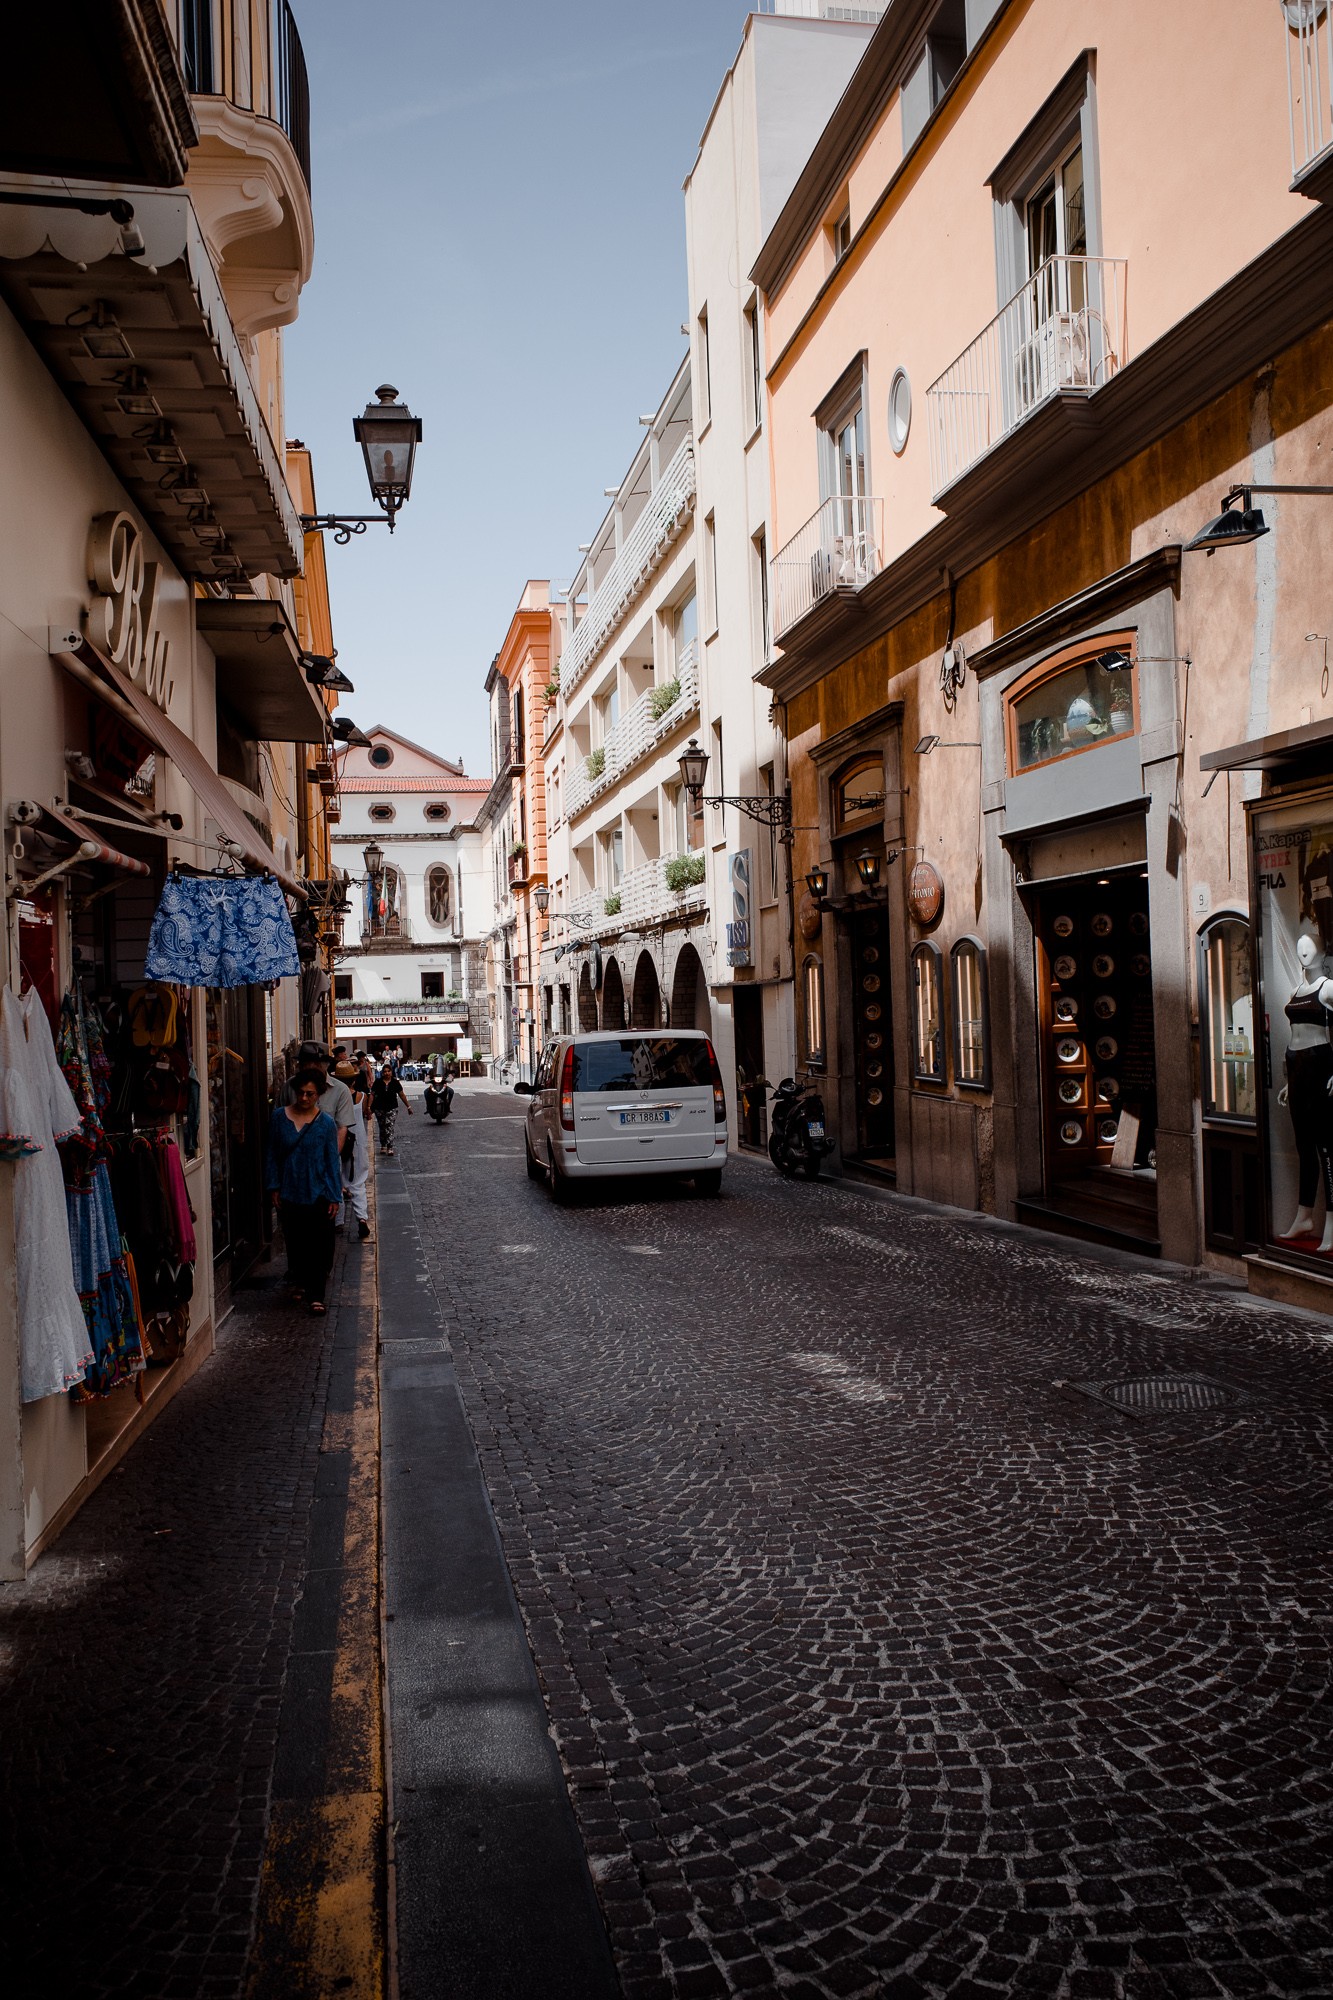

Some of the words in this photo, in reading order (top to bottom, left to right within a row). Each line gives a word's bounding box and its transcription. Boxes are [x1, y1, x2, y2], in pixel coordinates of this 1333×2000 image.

[1269, 830, 1312, 849] Kappa
[1257, 850, 1291, 869] PYREX
[1258, 872, 1286, 891] FILA
[1198, 894, 1204, 906] 9
[726, 920, 749, 948] TASSO
[336, 1017, 391, 1025] RISTORANTE
[626, 1113, 636, 1122] CR
